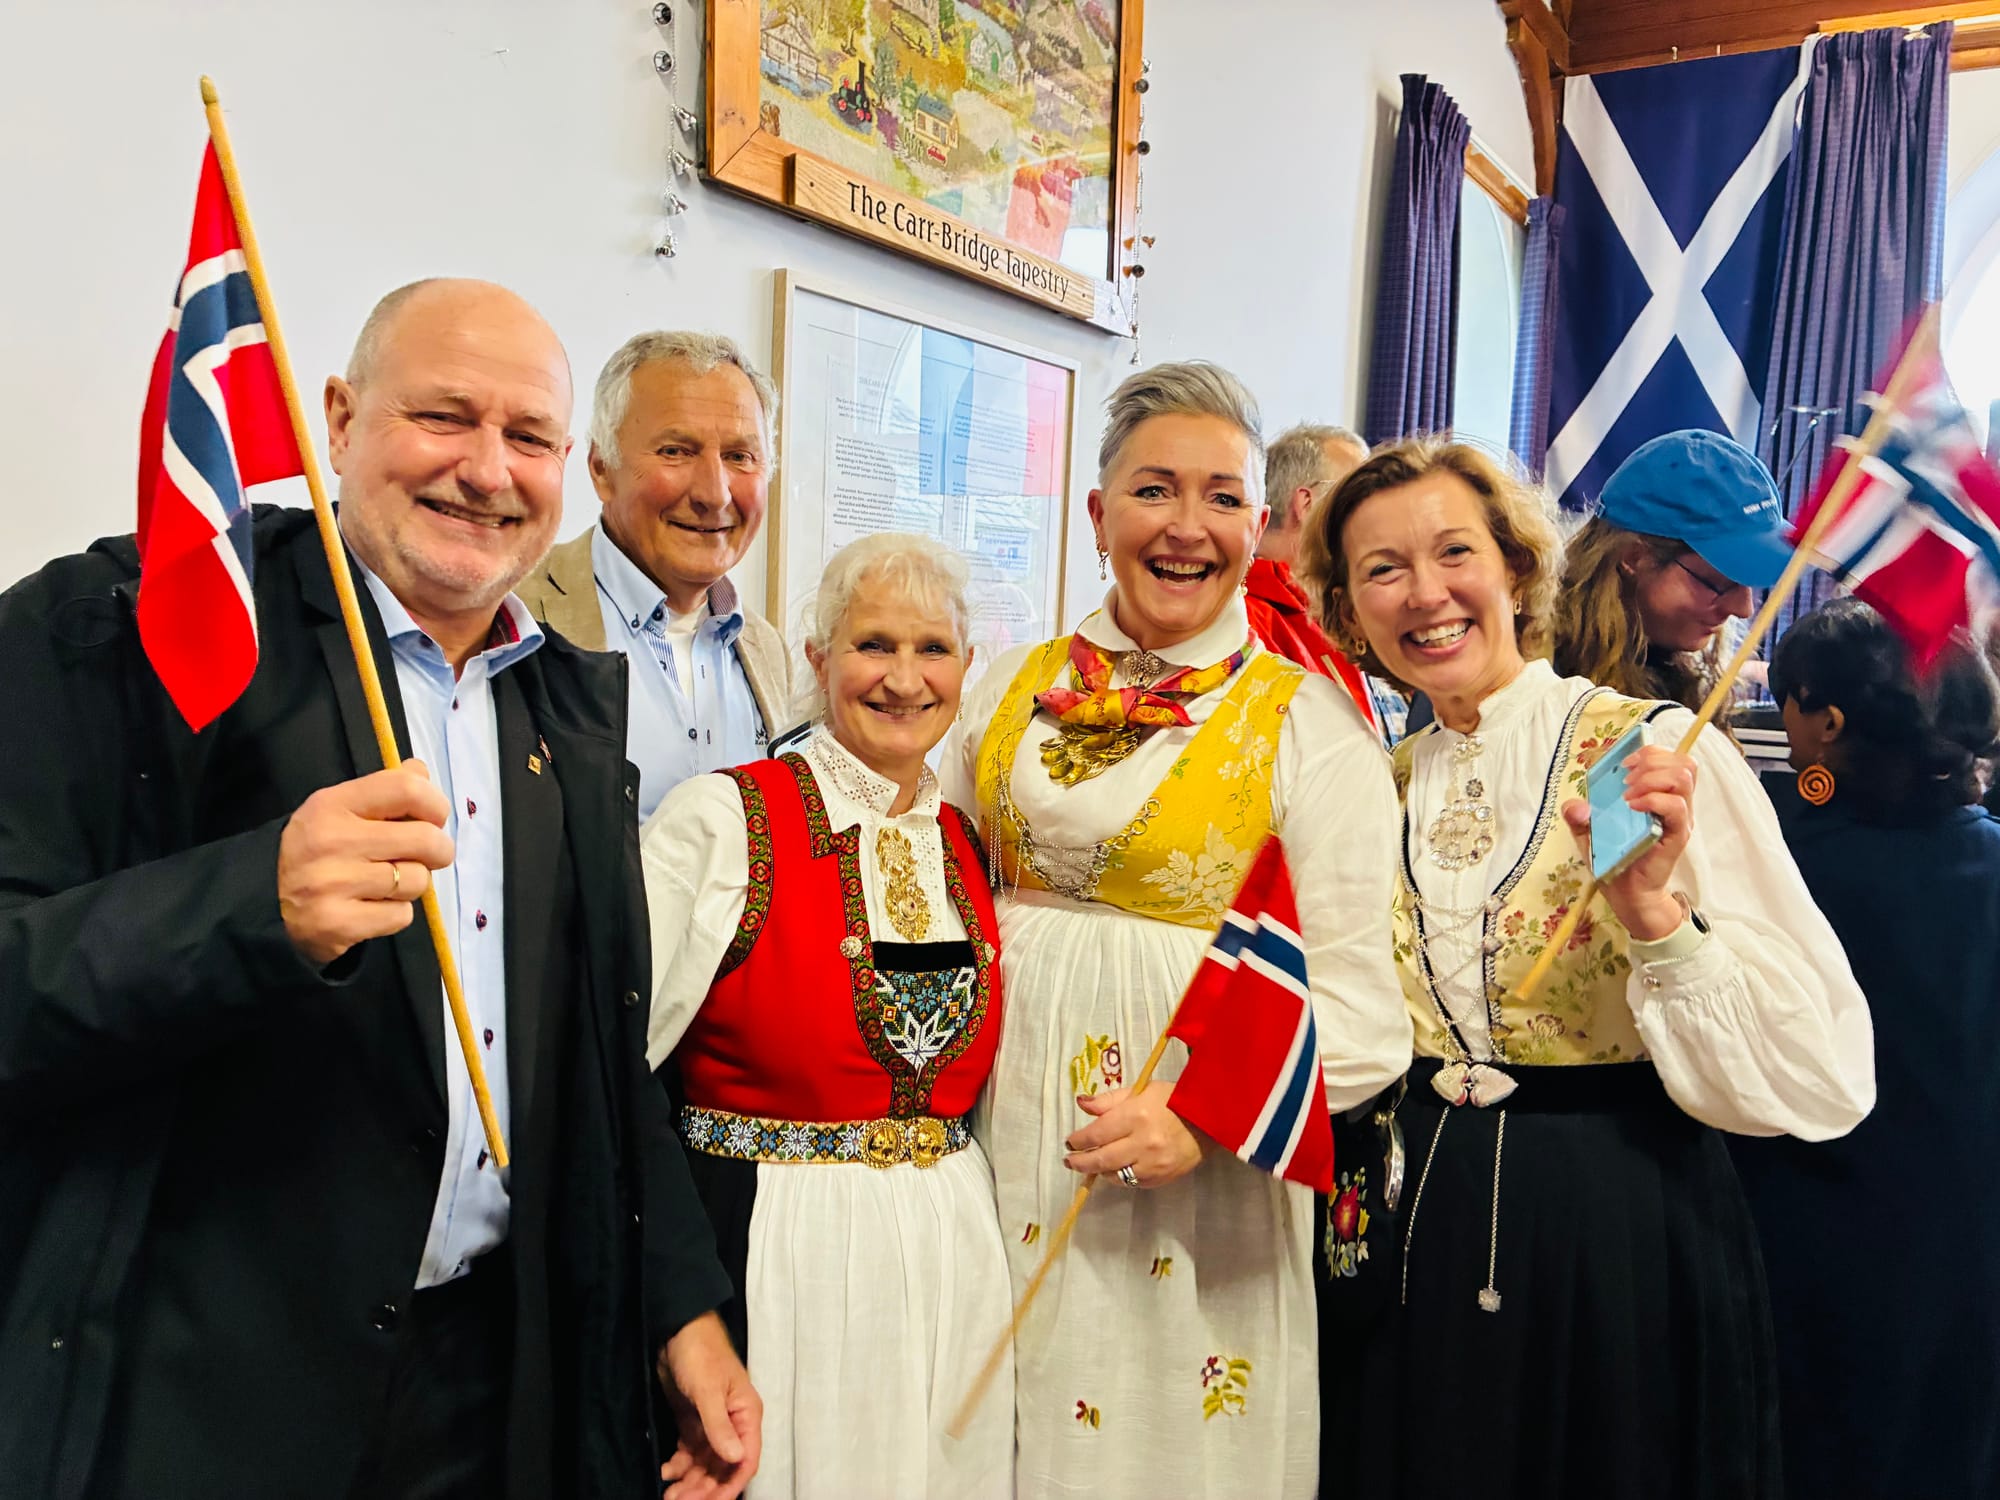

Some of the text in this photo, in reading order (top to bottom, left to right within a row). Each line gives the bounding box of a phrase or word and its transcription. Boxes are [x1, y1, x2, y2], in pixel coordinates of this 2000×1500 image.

[847, 181, 1069, 302] The Carr-Bridge Tapestry
